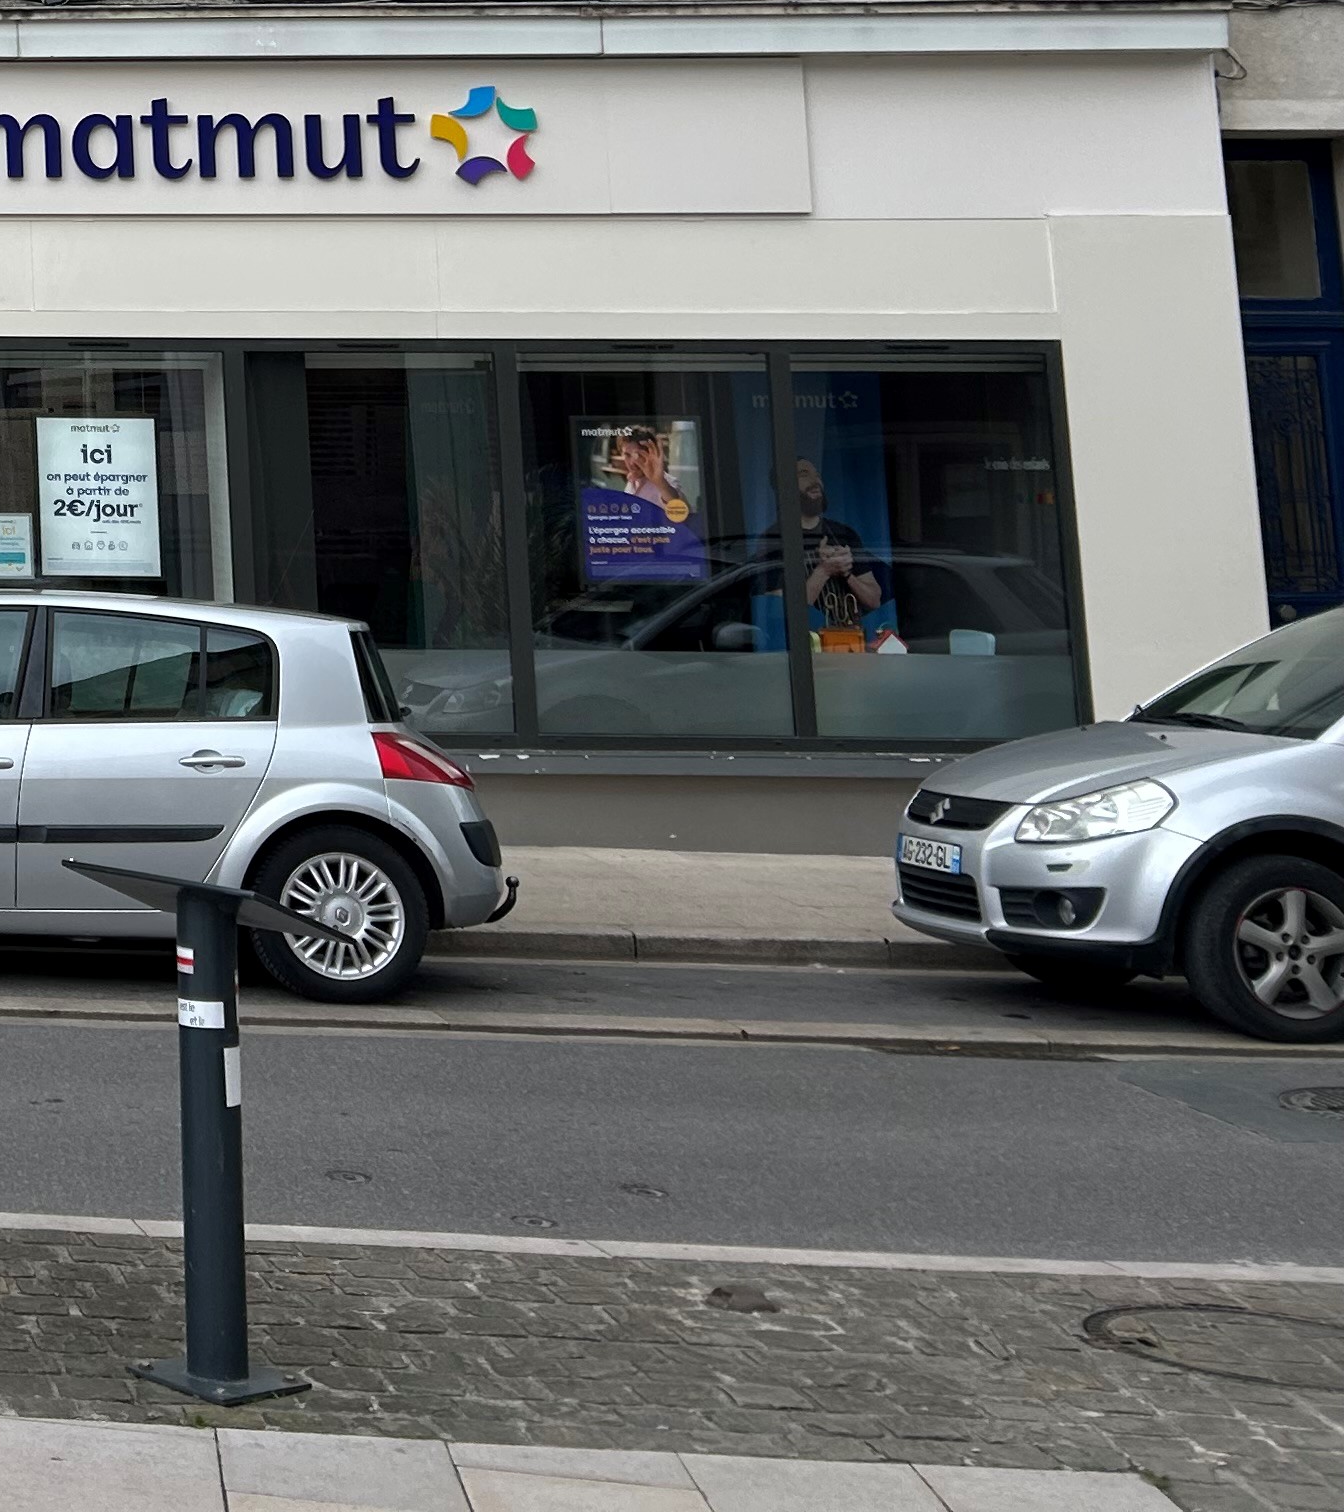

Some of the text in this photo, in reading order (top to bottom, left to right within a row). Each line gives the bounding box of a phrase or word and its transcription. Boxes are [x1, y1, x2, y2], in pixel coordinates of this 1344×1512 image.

[752, 392, 837, 409] mmut
[70, 424, 111, 433] matmut
[581, 428, 621, 437] matmut
[80, 444, 113, 464] ici
[46, 472, 148, 485] on peut épargner
[77, 486, 112, 498] partir
[113, 486, 130, 496] de
[630, 526, 676, 534] accessible
[612, 547, 632, 555] pour
